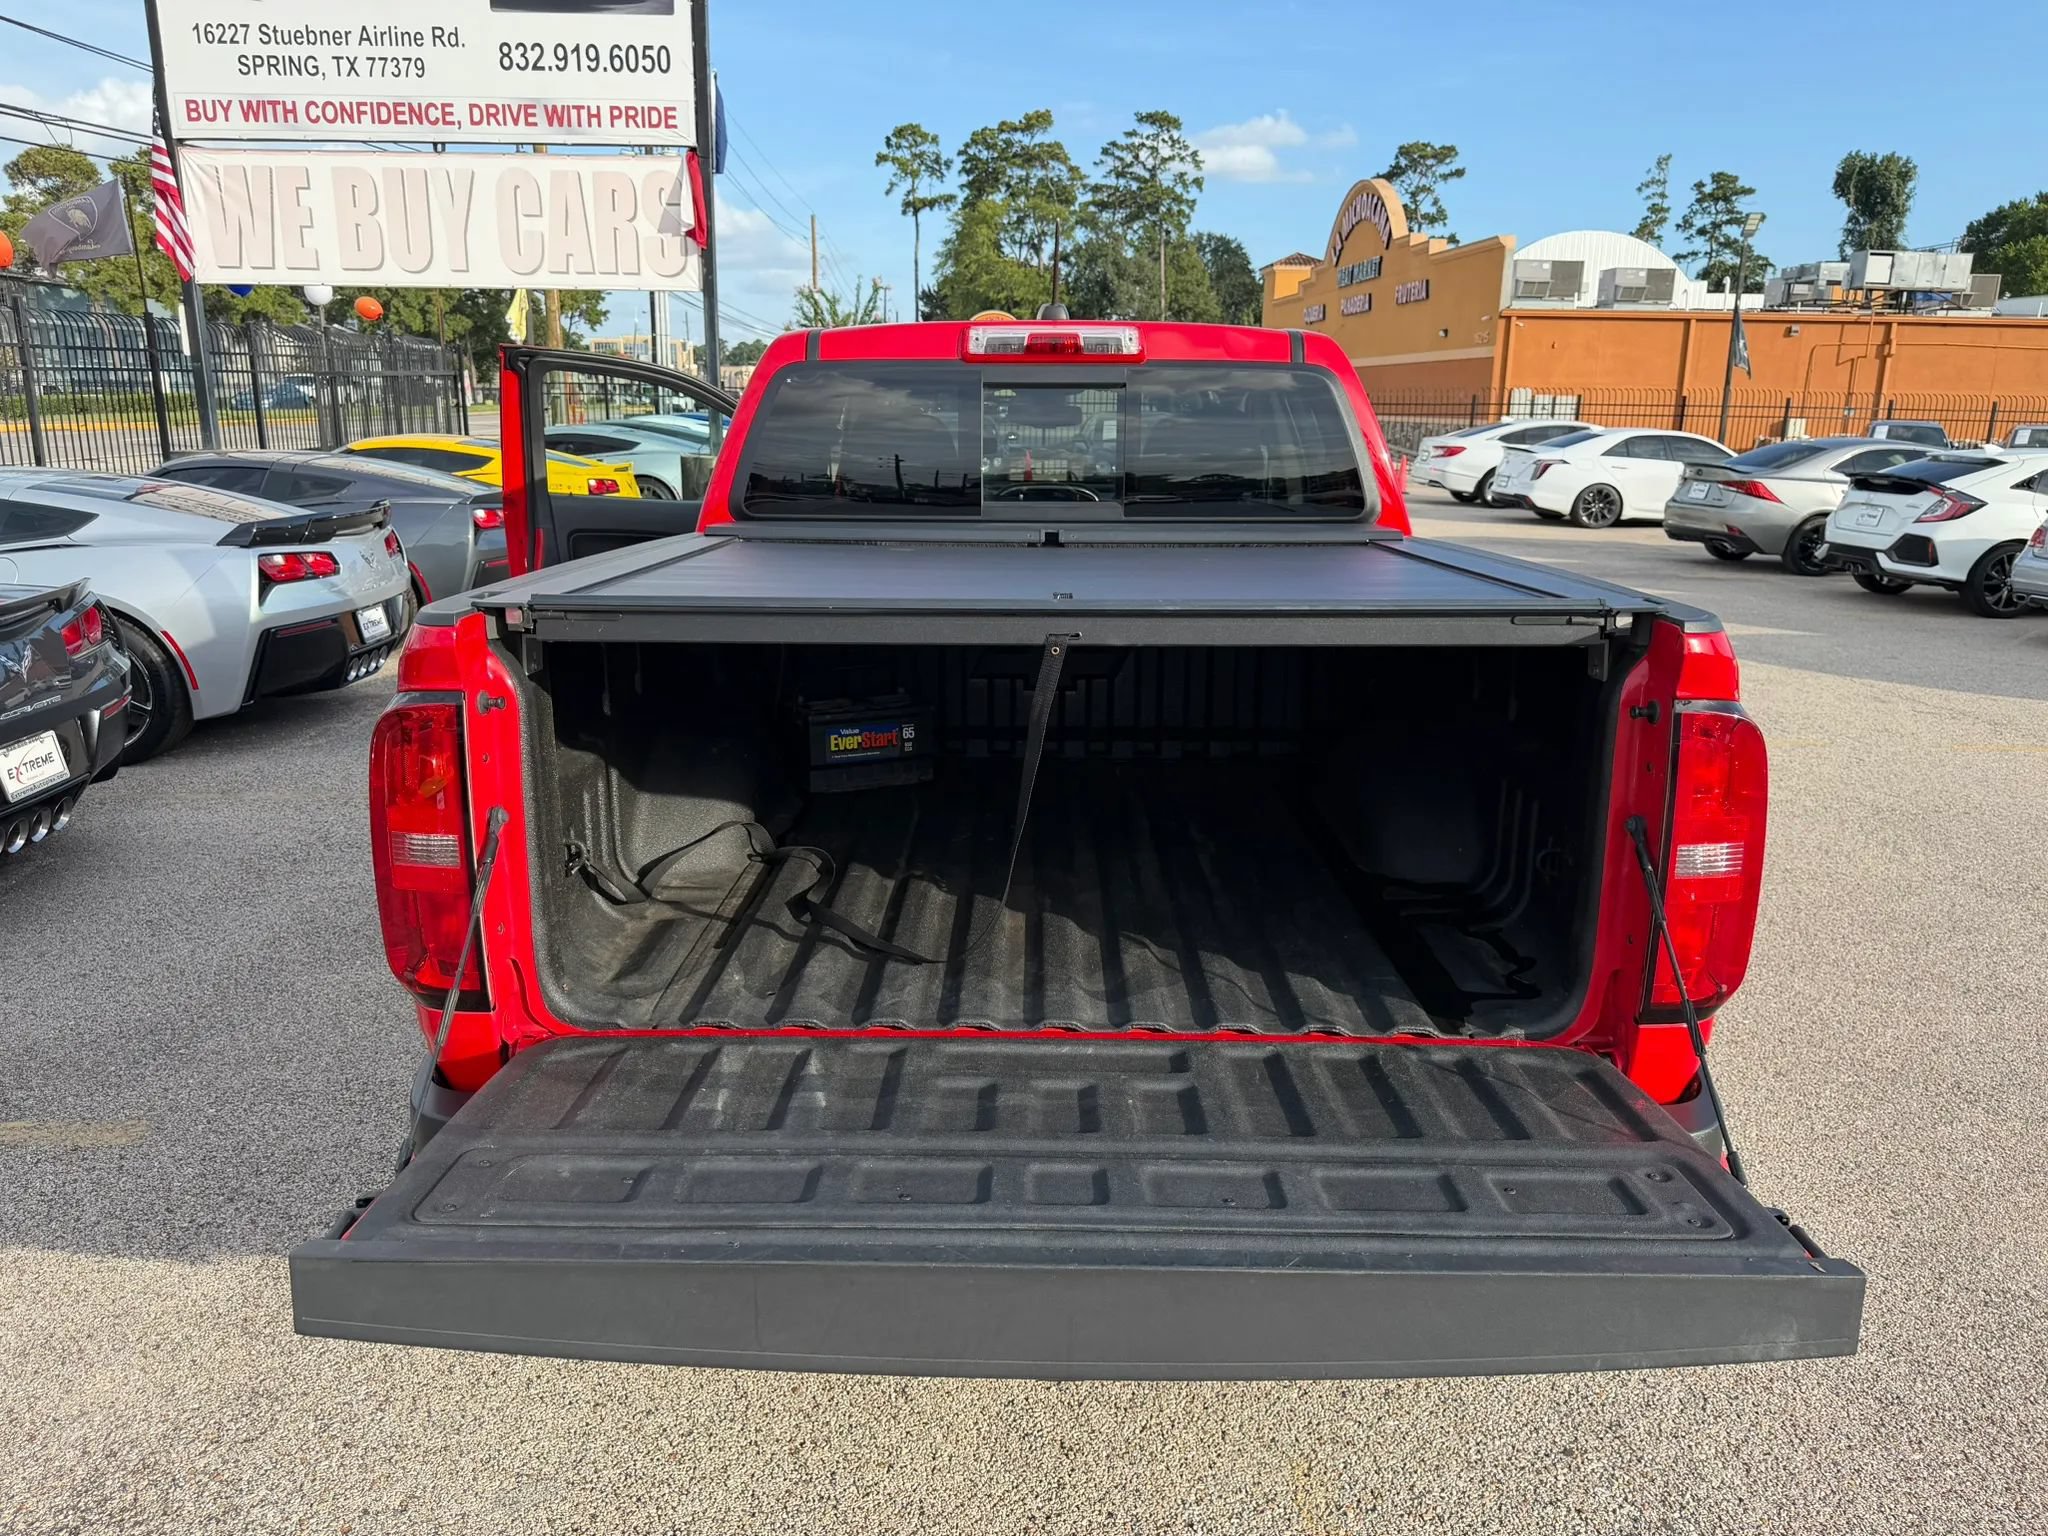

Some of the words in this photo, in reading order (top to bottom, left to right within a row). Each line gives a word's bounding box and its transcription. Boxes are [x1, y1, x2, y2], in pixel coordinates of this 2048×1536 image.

[192, 22, 250, 45] 16227
[258, 23, 352, 47] Stuebner
[358, 24, 425, 48] Airline
[431, 26, 466, 49] Rd.
[237, 54, 326, 80] SPRING,
[331, 55, 361, 78] TX
[365, 56, 426, 79] 77379
[498, 41, 672, 74] 832.919.6050
[185, 100, 233, 123] BUY
[239, 100, 298, 124] WITH
[305, 101, 464, 130] CONFIDENCE,
[469, 103, 538, 128] DRIVE
[543, 105, 602, 129] WITH
[609, 106, 679, 130] PRIDE
[201, 164, 321, 271] WE
[331, 165, 475, 274] BUY
[496, 166, 689, 279] CARS
[830, 730, 898, 752] EverStart
[903, 727, 915, 738] 65
[7, 751, 55, 780] EXTREME
